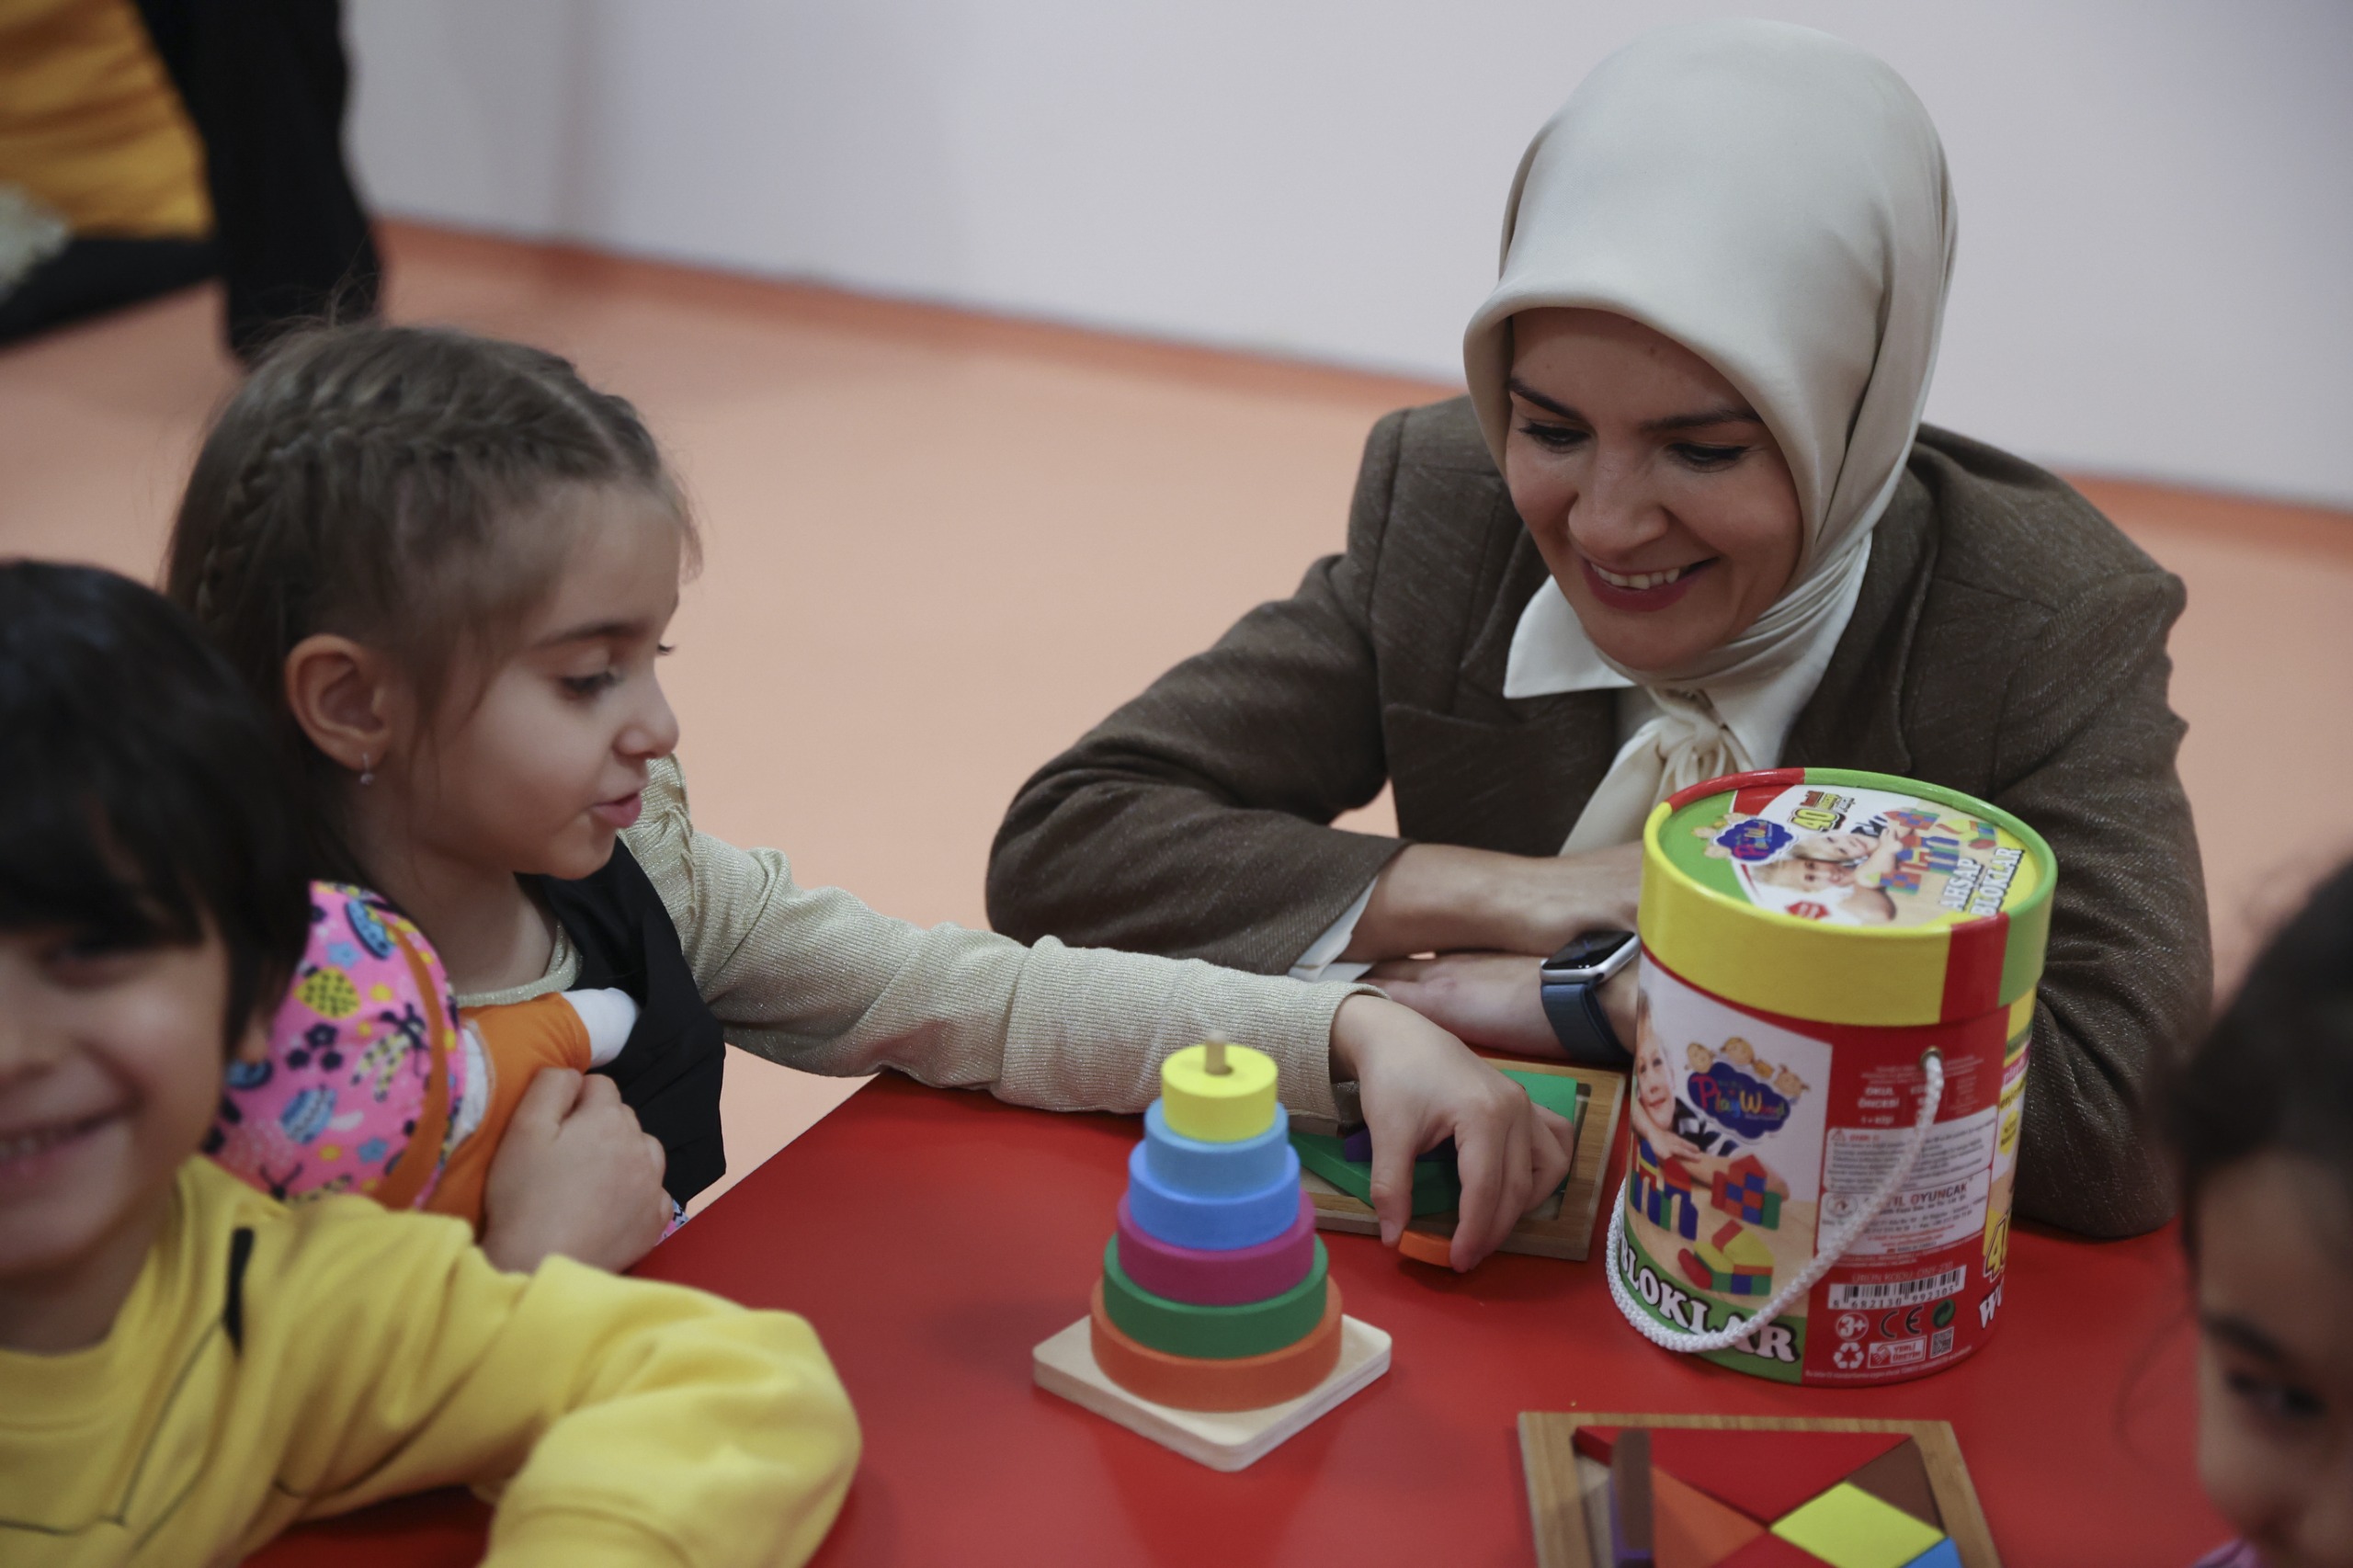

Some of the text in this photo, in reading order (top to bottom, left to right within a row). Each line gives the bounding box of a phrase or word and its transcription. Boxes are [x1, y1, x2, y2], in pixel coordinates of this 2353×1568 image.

[1790, 807, 1838, 833] 40
[1970, 847, 2025, 917] BLOKLAR
[1910, 1182, 1967, 1205] OYUNCAK
[1851, 1297, 1902, 1310] 682130
[1912, 1285, 1954, 1303] 992305
[1839, 1315, 1867, 1338] 3+
